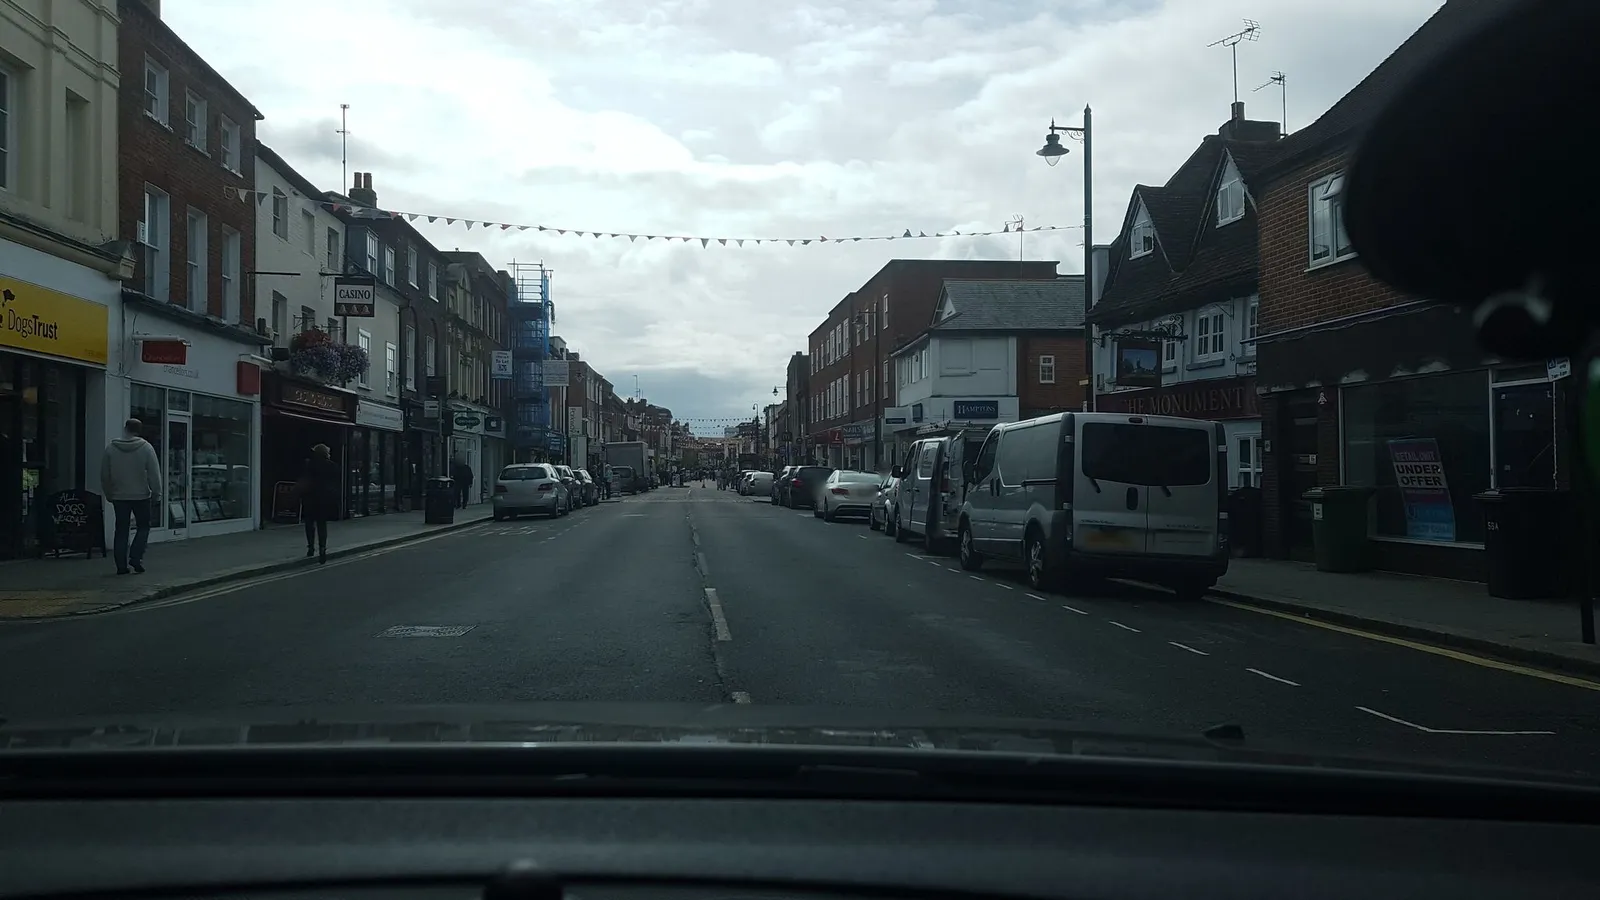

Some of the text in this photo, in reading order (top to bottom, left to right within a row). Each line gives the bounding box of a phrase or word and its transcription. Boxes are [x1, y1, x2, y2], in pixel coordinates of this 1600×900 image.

[339, 289, 370, 299] CASINO
[1150, 386, 1245, 415] MONUMENT
[958, 405, 996, 414] HAMPTONS
[1396, 464, 1440, 474] UNDER
[1401, 476, 1442, 486] OFFER
[56, 503, 85, 515] DOGS
